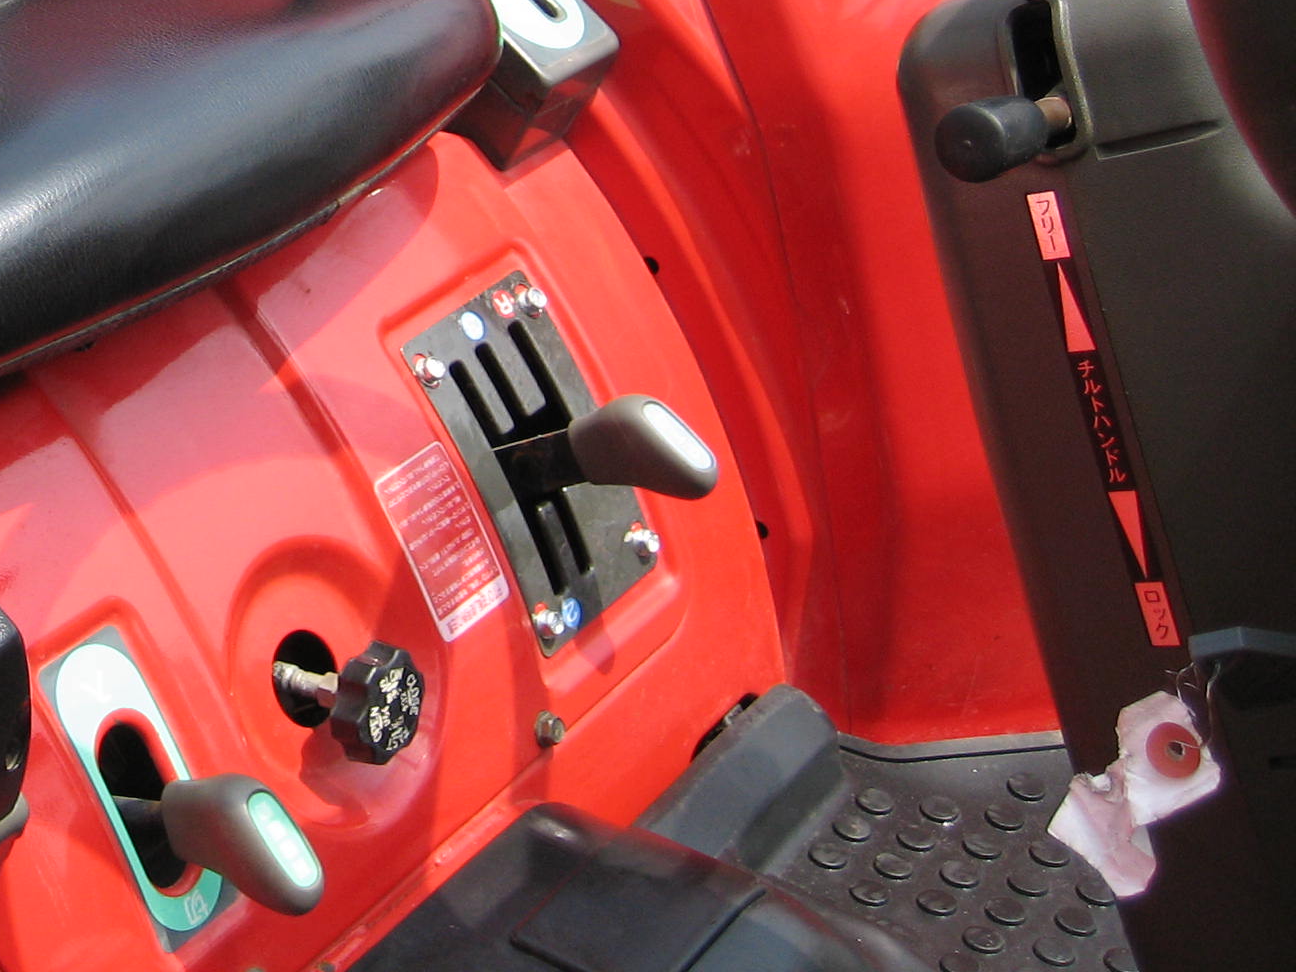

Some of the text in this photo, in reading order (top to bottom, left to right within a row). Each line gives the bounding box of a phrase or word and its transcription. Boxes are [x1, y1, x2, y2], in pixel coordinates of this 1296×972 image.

[1036, 199, 1056, 253] フリー
[494, 293, 514, 315] R
[1077, 359, 1126, 484] チルトハンドル
[564, 601, 579, 623] 2
[1144, 590, 1169, 641] ロック
[369, 706, 384, 743] OPEN
